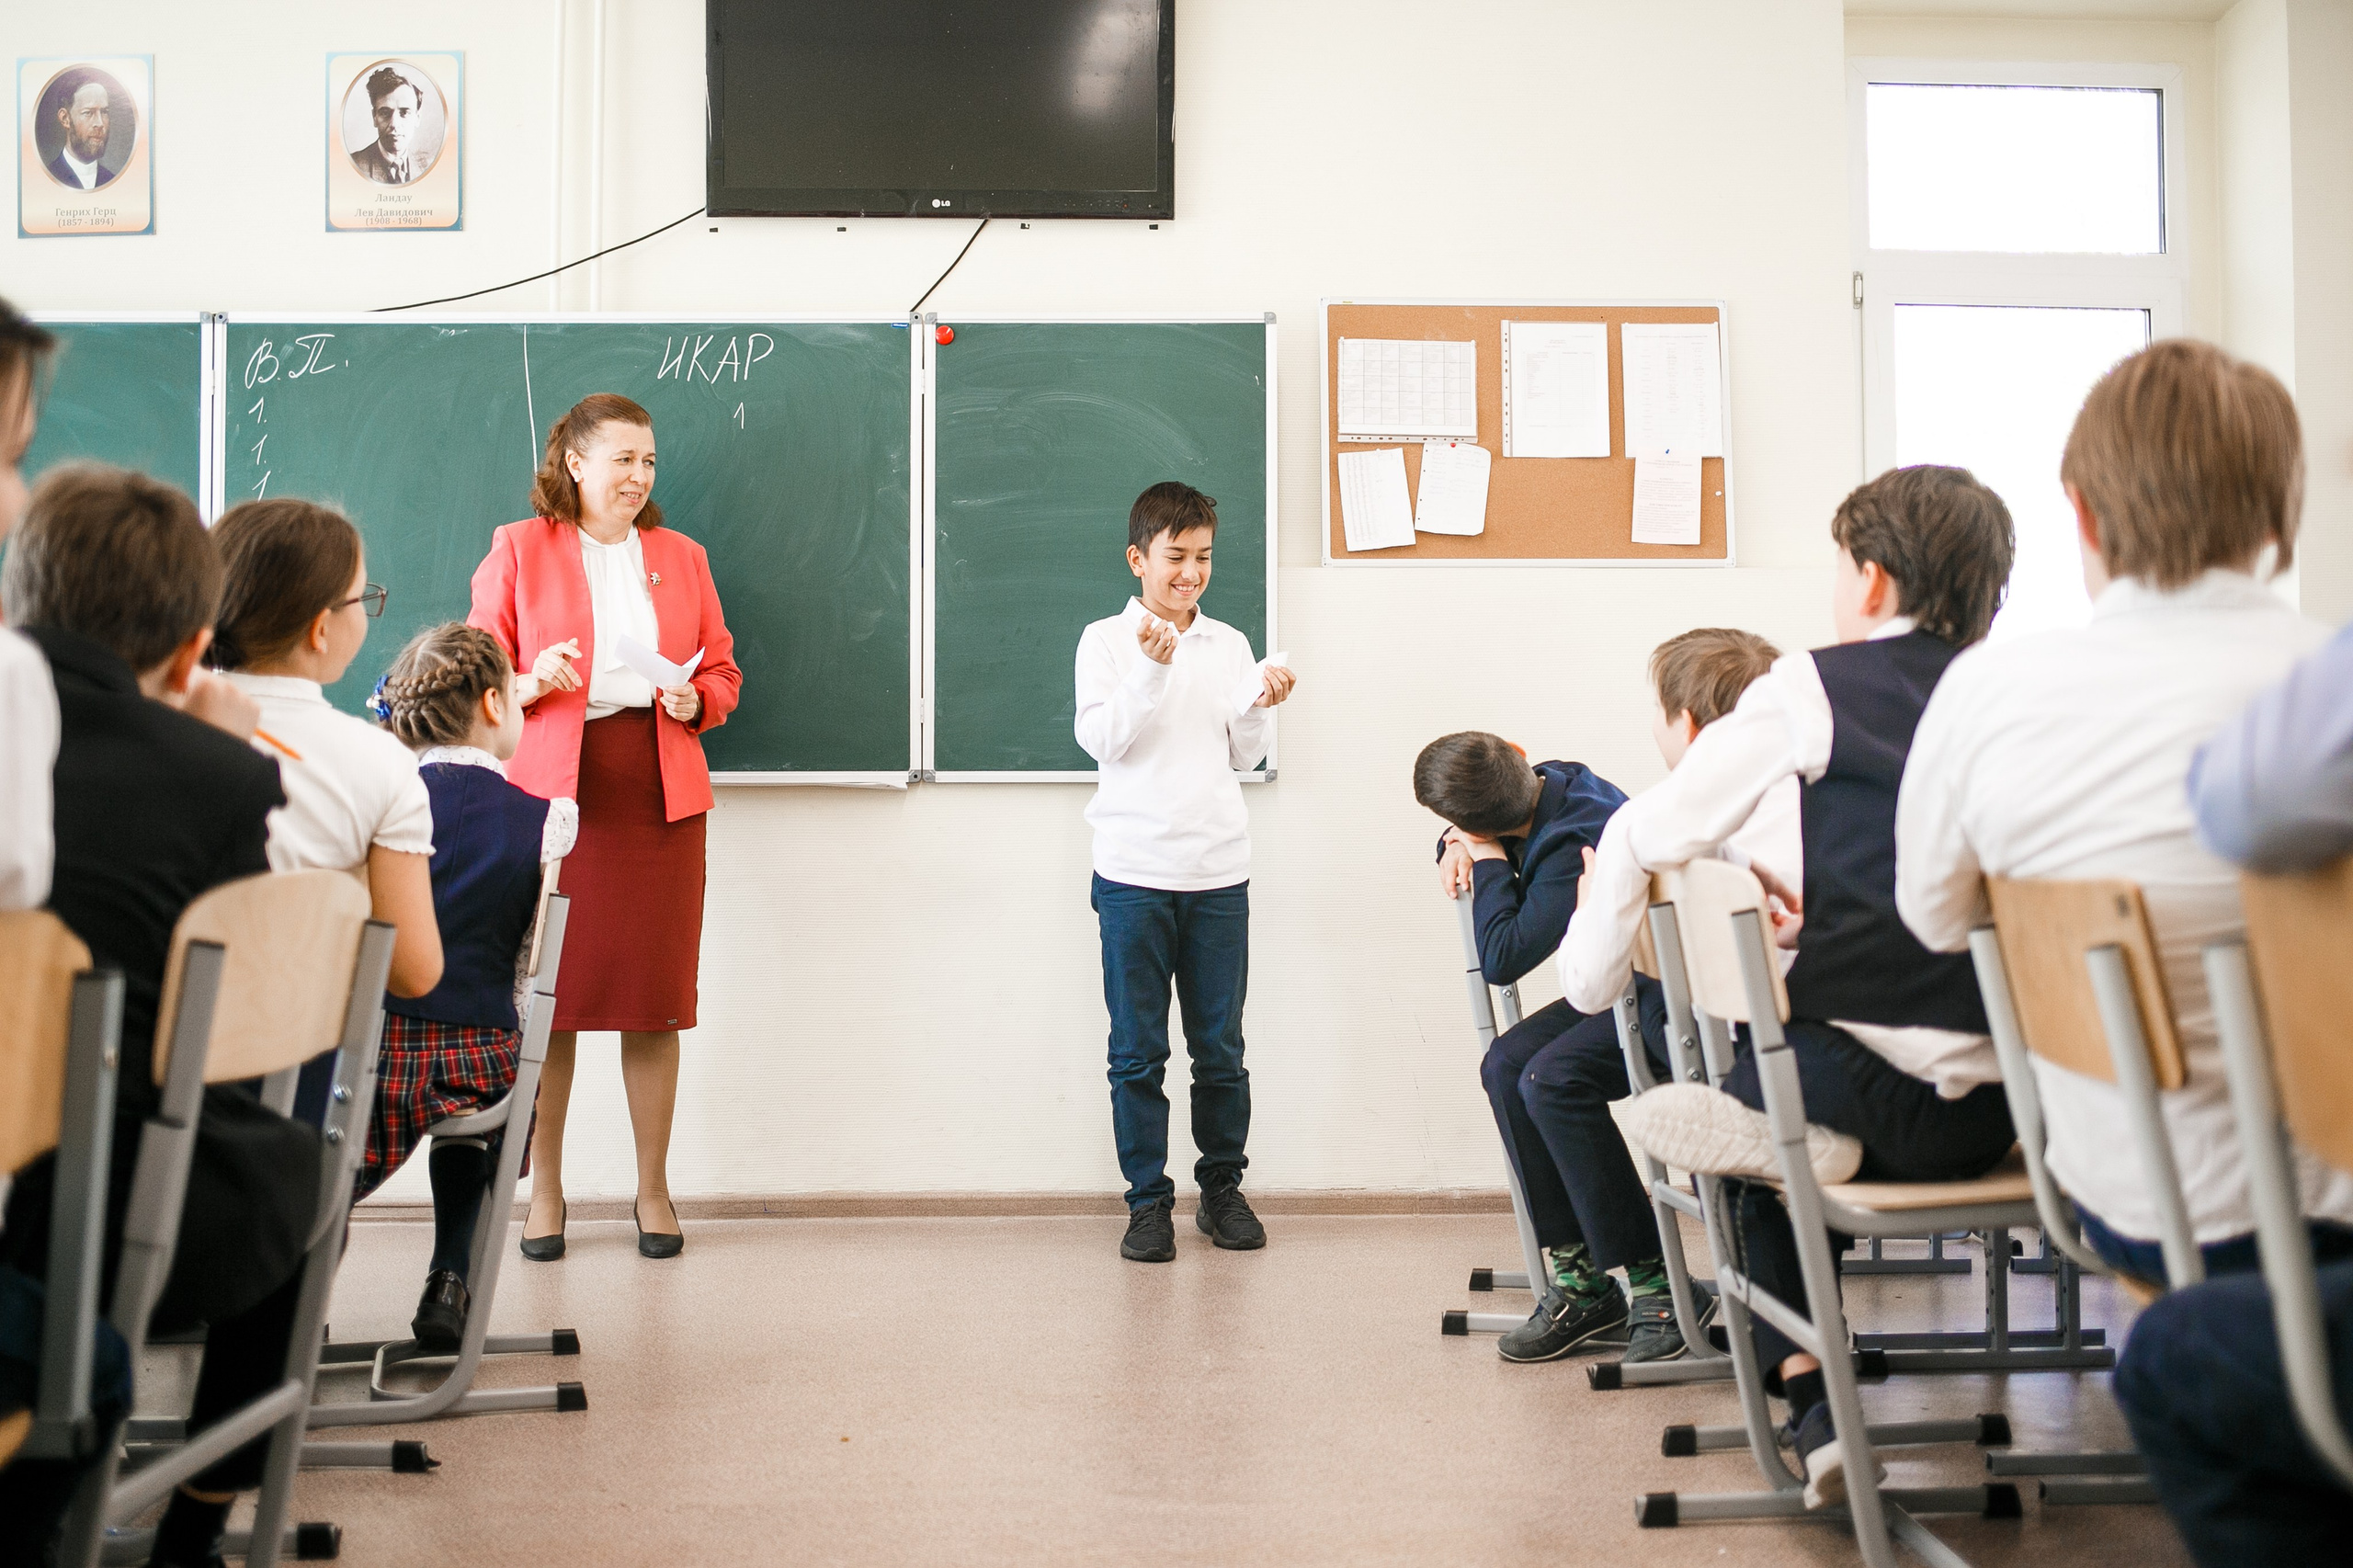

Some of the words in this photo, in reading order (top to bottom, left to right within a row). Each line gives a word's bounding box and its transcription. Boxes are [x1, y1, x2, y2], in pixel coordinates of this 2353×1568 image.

[375, 193, 413, 204] Ландау
[55, 208, 91, 218] Генрих
[93, 207, 118, 217] Герц
[354, 209, 374, 218] Лев
[376, 208, 434, 219] Давидович
[58, 219, 83, 228] (1857
[90, 217, 114, 227] 1894)
[365, 217, 391, 226] (1908
[398, 217, 423, 226] 1968)
[657, 333, 775, 384] ИКАР
[733, 402, 745, 430] 1
